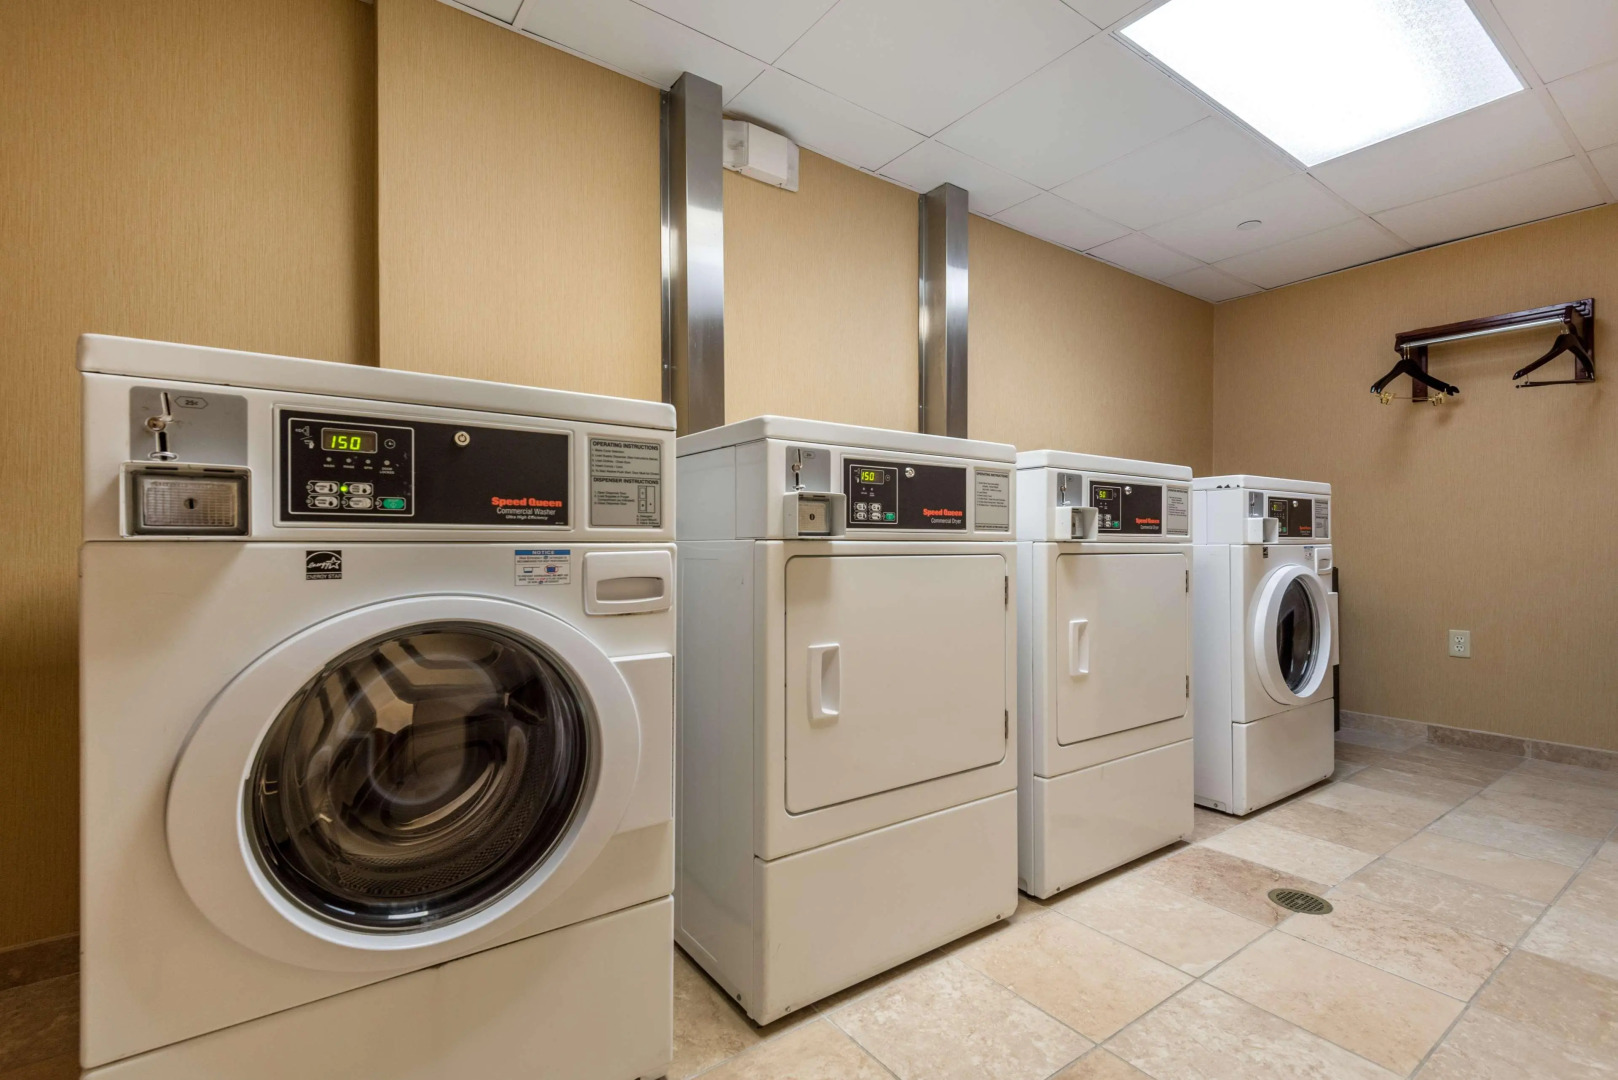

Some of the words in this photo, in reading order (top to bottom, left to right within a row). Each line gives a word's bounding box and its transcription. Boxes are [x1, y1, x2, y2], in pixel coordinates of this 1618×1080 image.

[331, 436, 361, 450] 150
[862, 472, 875, 481] 150
[491, 497, 527, 507] Speed
[528, 498, 562, 507] Queen
[923, 508, 943, 517] Speed
